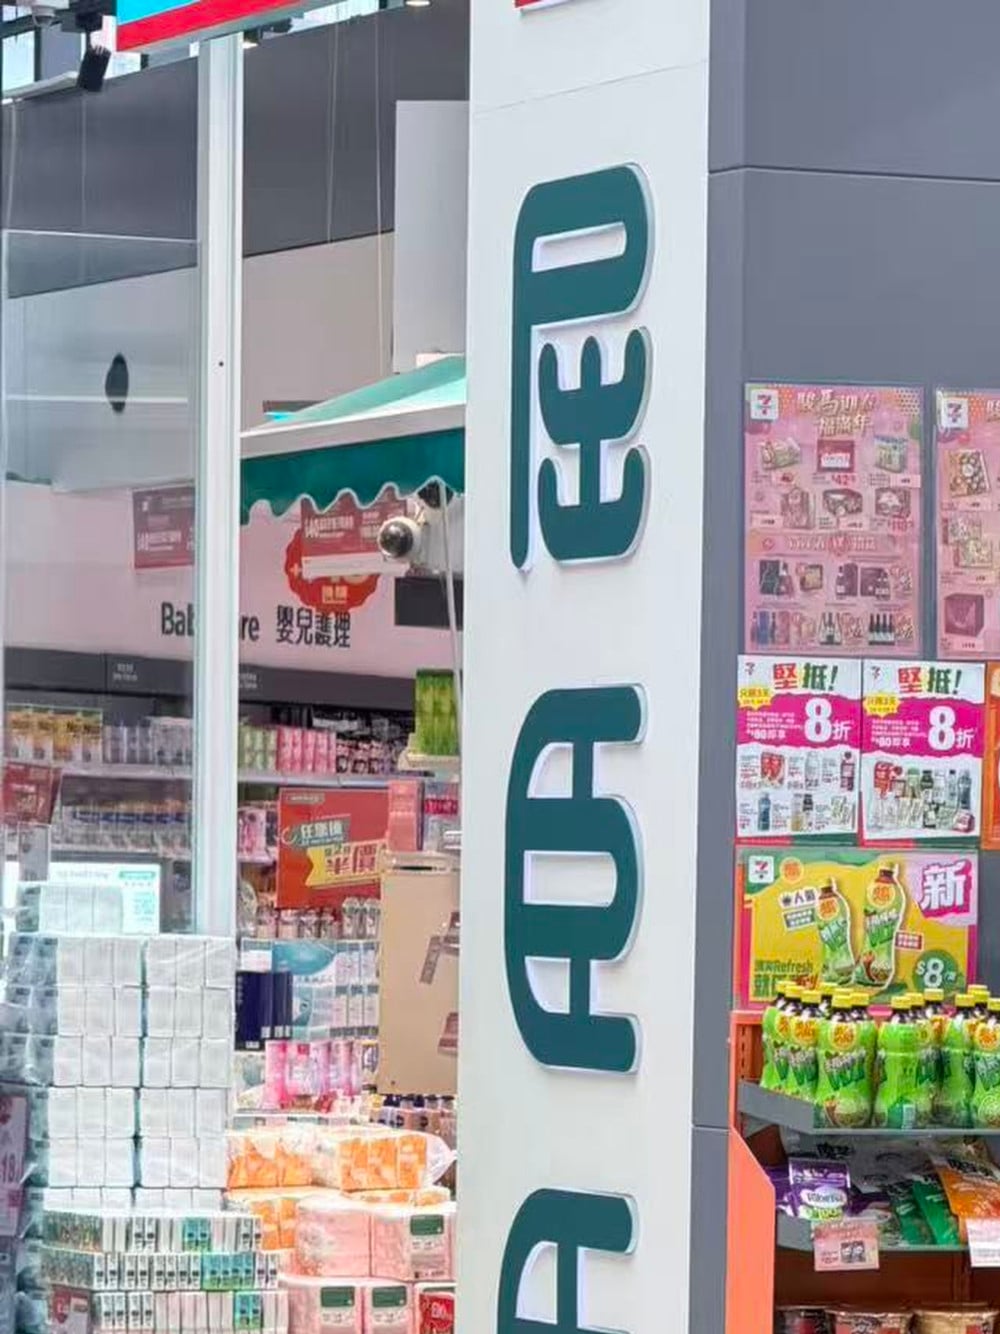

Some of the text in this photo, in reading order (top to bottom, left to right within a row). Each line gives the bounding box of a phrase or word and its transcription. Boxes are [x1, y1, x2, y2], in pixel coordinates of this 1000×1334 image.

[275, 604, 351, 648] 嬰兒護理
[920, 862, 968, 913] 新
